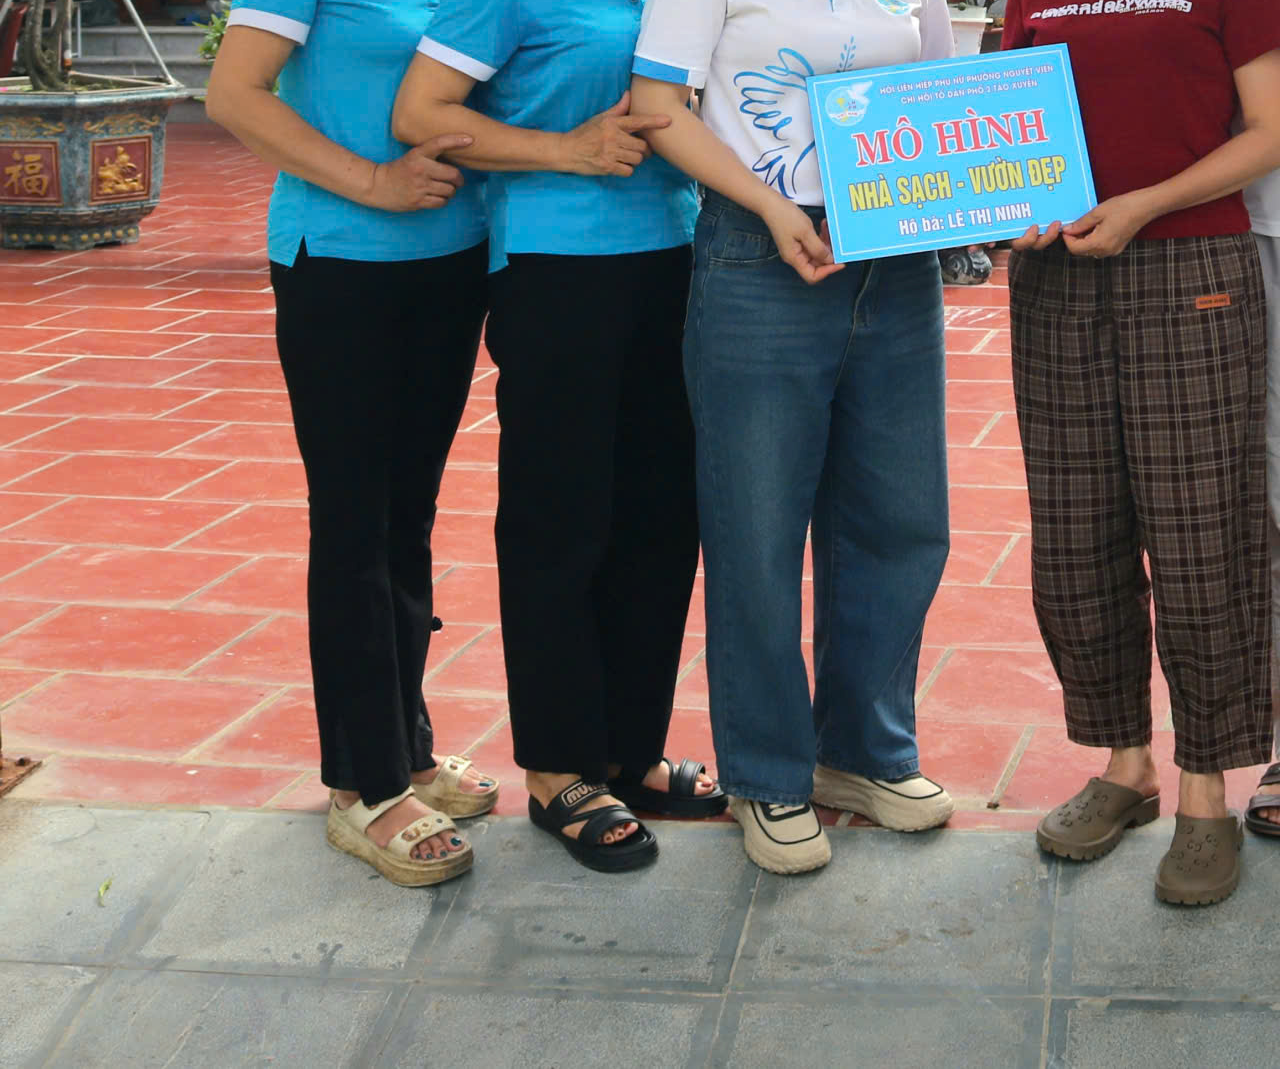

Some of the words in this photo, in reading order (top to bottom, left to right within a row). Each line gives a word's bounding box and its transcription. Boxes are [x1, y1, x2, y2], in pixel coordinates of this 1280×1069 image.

[851, 115, 923, 167] MÔ
[932, 107, 1050, 155] HÌNH
[848, 174, 894, 212] NHÀ
[896, 170, 952, 210] SẠCH
[968, 156, 1025, 195] VƯỜN
[1027, 155, 1067, 191] ĐẸP
[899, 218, 918, 237] Hộ
[948, 209, 965, 229] LÊ
[968, 207, 992, 227] THỊ
[995, 202, 1032, 222] NINH
